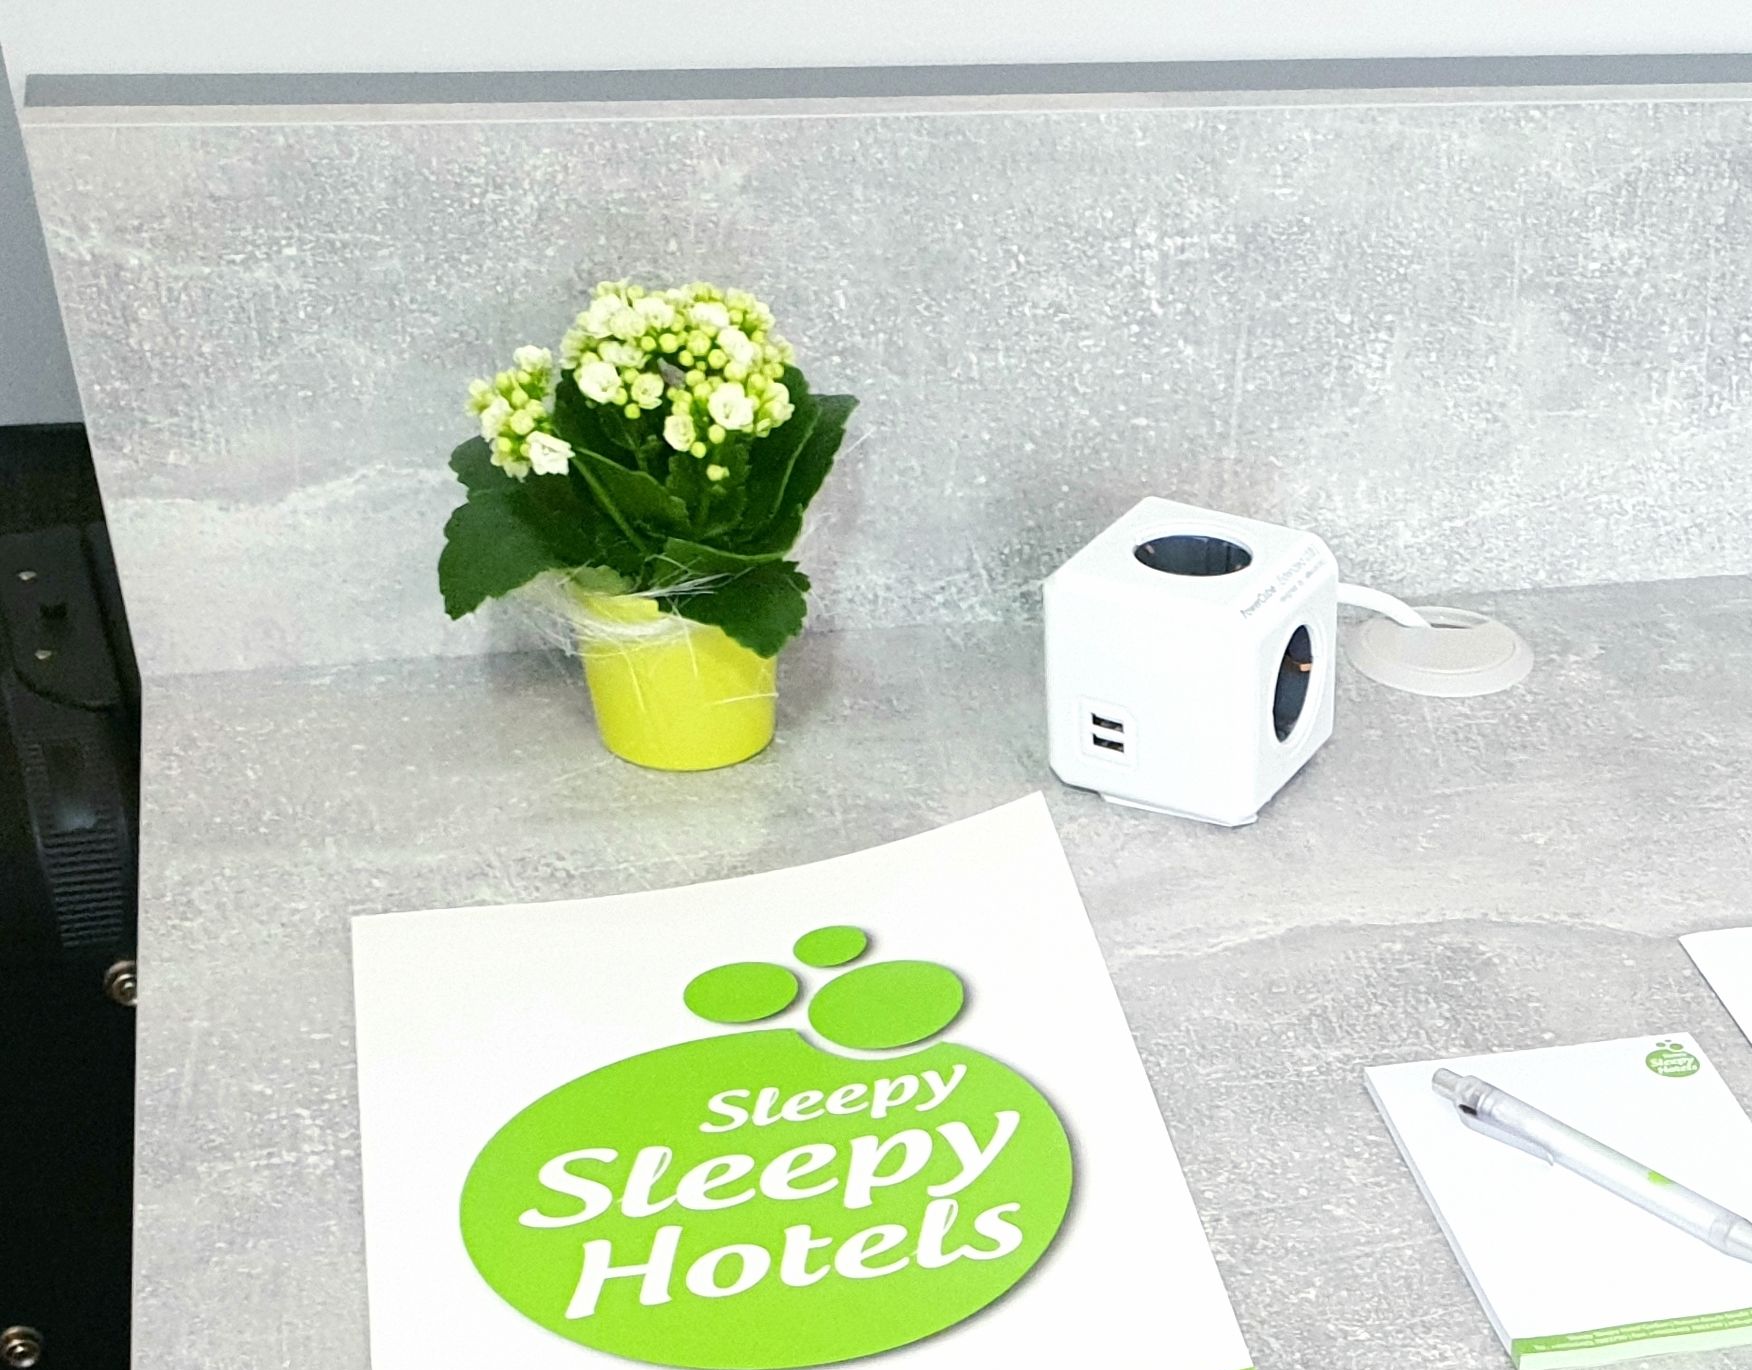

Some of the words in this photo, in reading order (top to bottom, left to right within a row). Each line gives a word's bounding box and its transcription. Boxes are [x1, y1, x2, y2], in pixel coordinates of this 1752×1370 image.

[700, 1064, 967, 1133] Sleepy
[519, 1111, 1020, 1227] Sleepy
[564, 1200, 1023, 1319] Hotels
